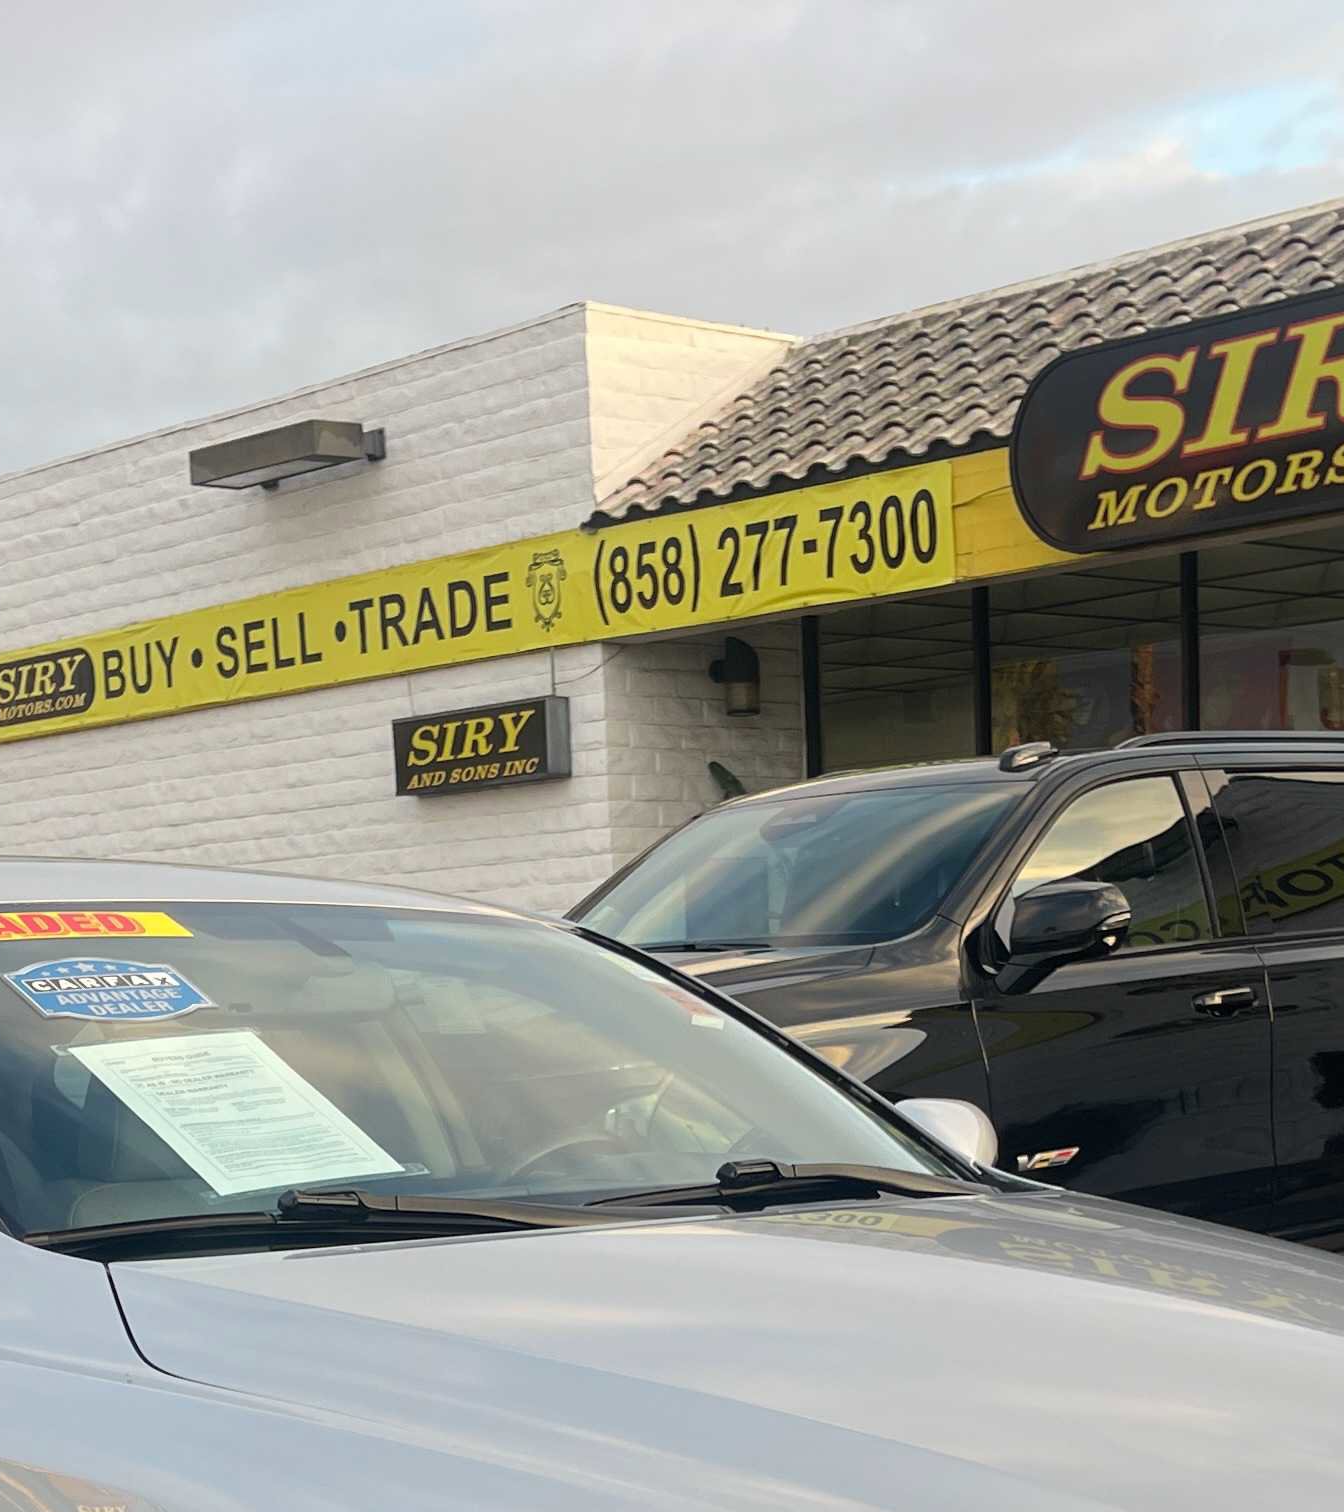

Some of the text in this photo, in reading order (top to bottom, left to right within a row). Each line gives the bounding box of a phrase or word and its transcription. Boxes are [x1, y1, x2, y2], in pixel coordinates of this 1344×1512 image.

[594, 488, 938, 626] (858) 277-7300
[102, 572, 513, 699] BUY SELL TRADE
[407, 710, 536, 767] SIRY
[407, 757, 540, 789] AND SONS INC
[27, 973, 176, 993] CARFAX
[57, 988, 182, 1006] ADVANTAGE
[88, 1001, 174, 1015] DEALER
